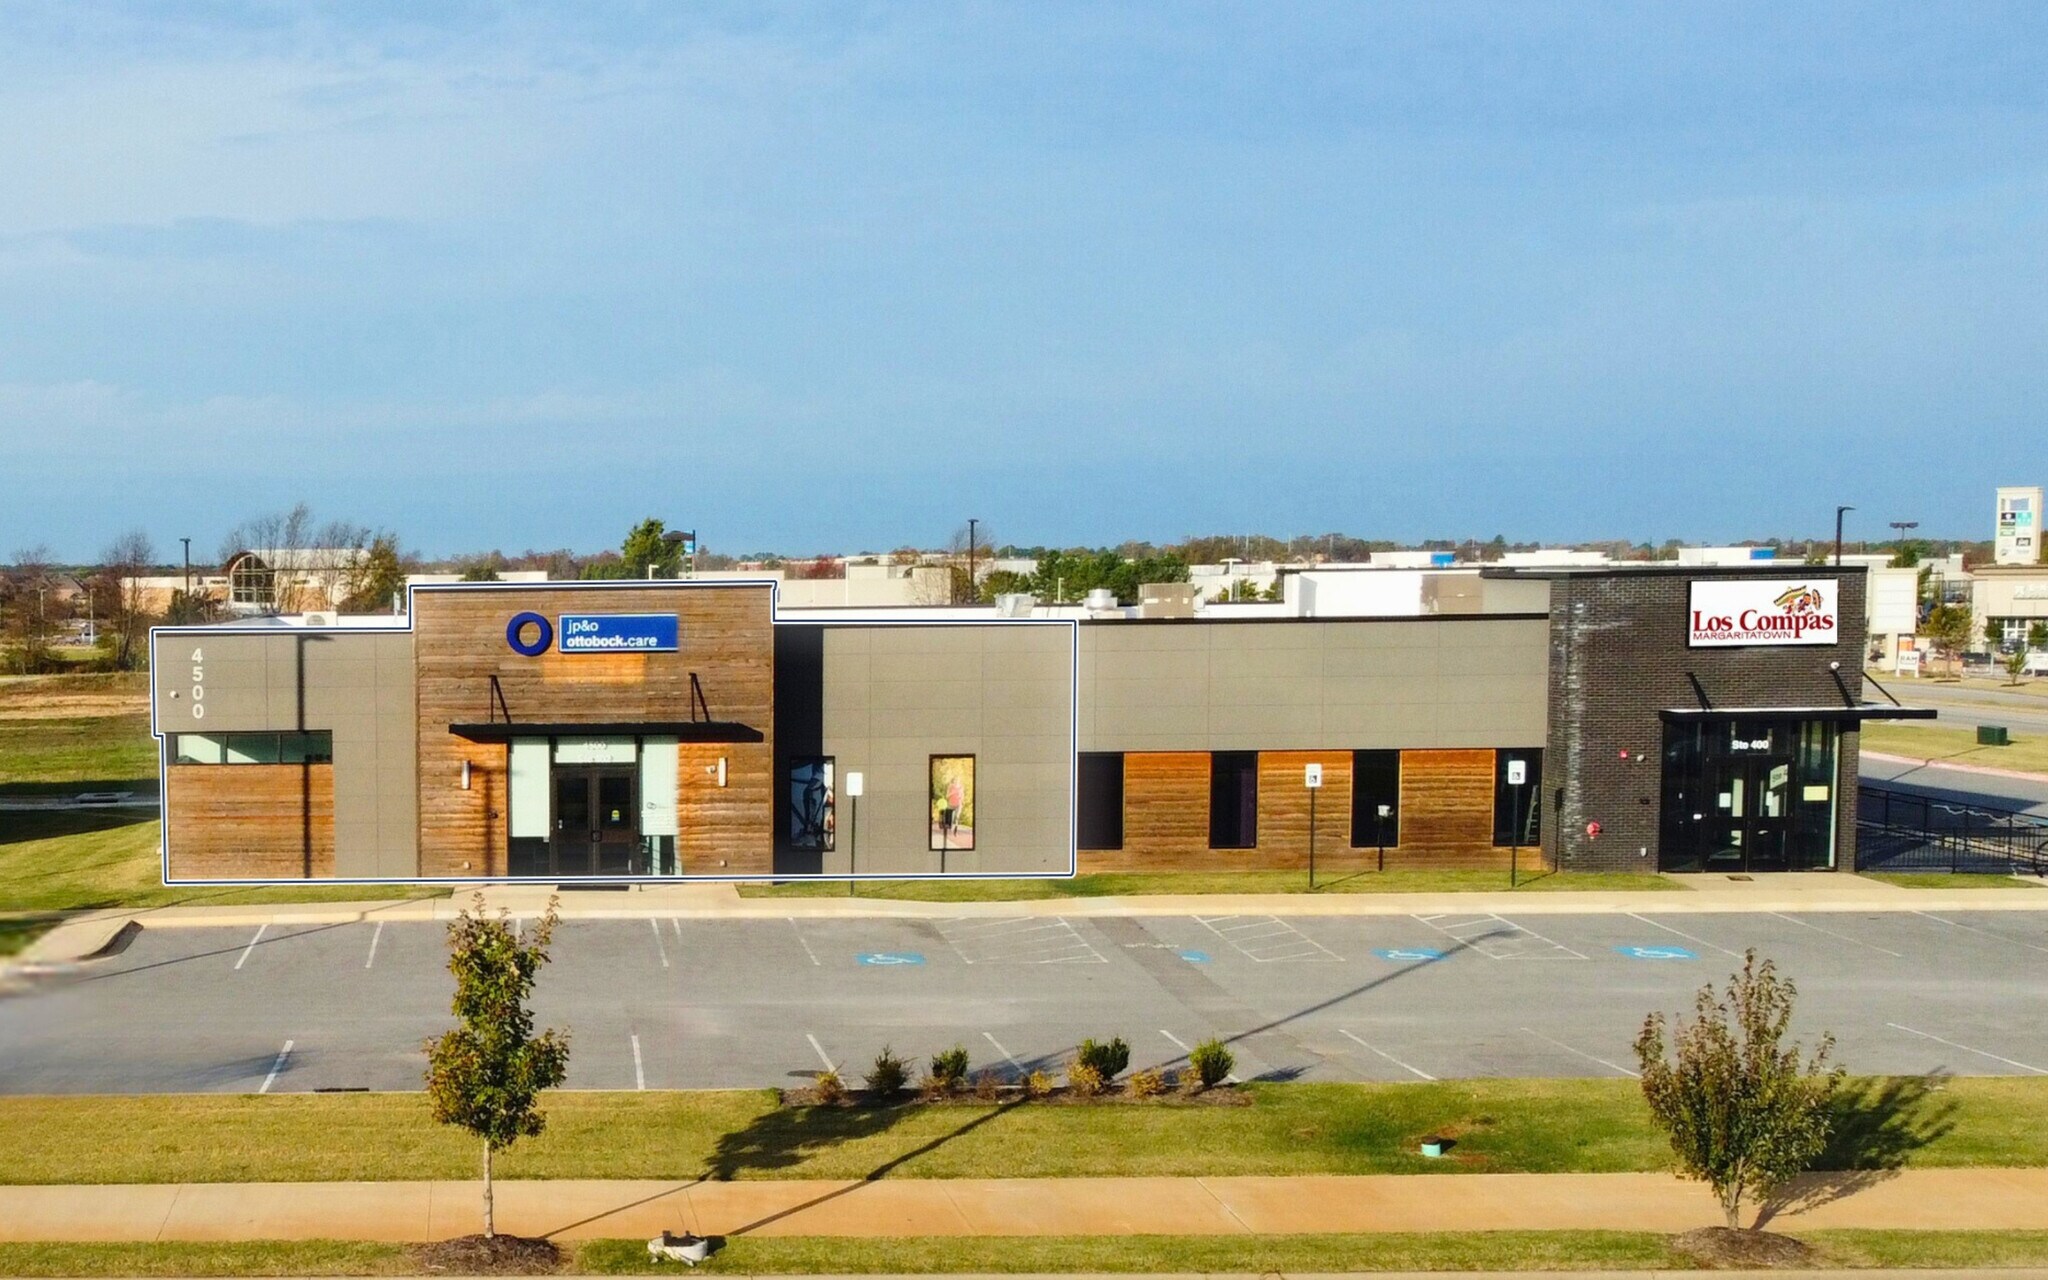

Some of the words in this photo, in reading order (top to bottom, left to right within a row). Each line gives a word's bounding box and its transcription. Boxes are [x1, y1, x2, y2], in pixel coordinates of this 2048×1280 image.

[567, 620, 599, 635] jp&o
[1693, 610, 1733, 632] Los
[1739, 609, 1834, 639] Compas
[566, 635, 658, 647] ottobock.care
[1693, 631, 1791, 640] MARGARITATOWN
[191, 648, 204, 719] 4500
[1751, 740, 1769, 750] 400
